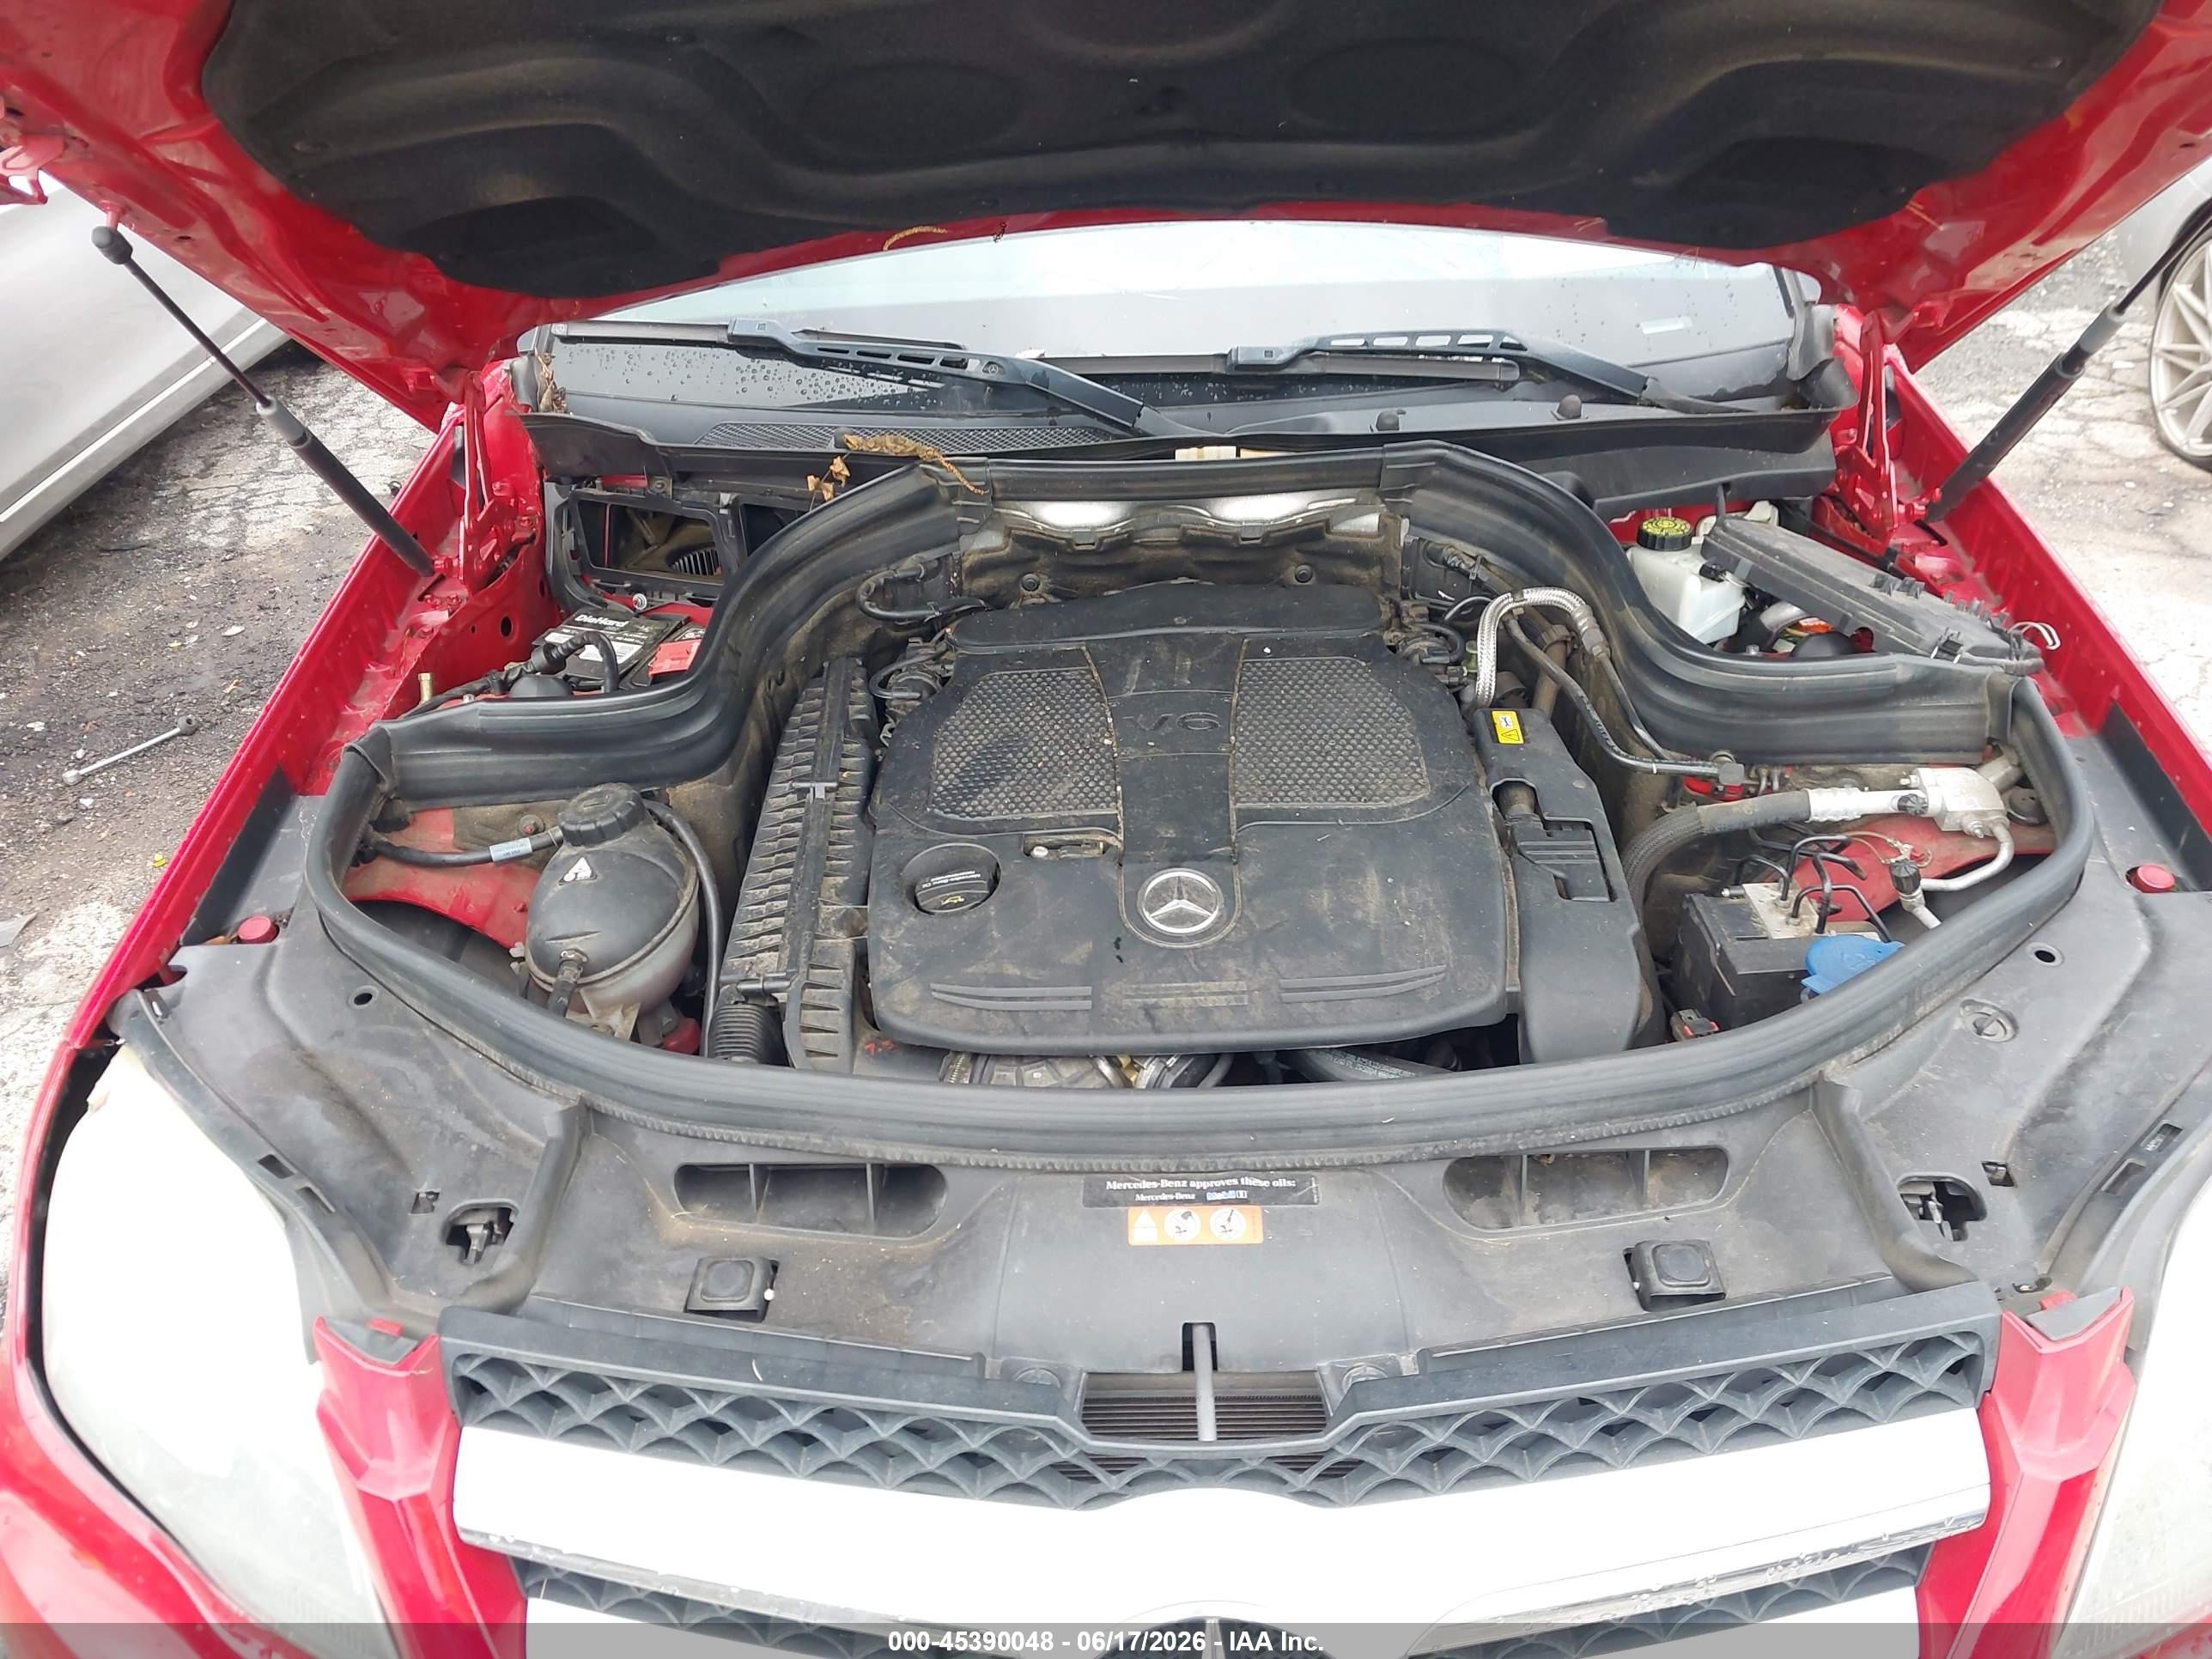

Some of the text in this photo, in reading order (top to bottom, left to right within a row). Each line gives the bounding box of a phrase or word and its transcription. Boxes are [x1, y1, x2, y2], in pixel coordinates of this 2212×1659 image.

[574, 614, 630, 629] DieHard
[1136, 711, 1221, 732] V6
[1105, 1176, 1296, 1190] Mercedes-Benz approves these oils:
[1134, 1192, 1195, 1201] Mercedes-Benz
